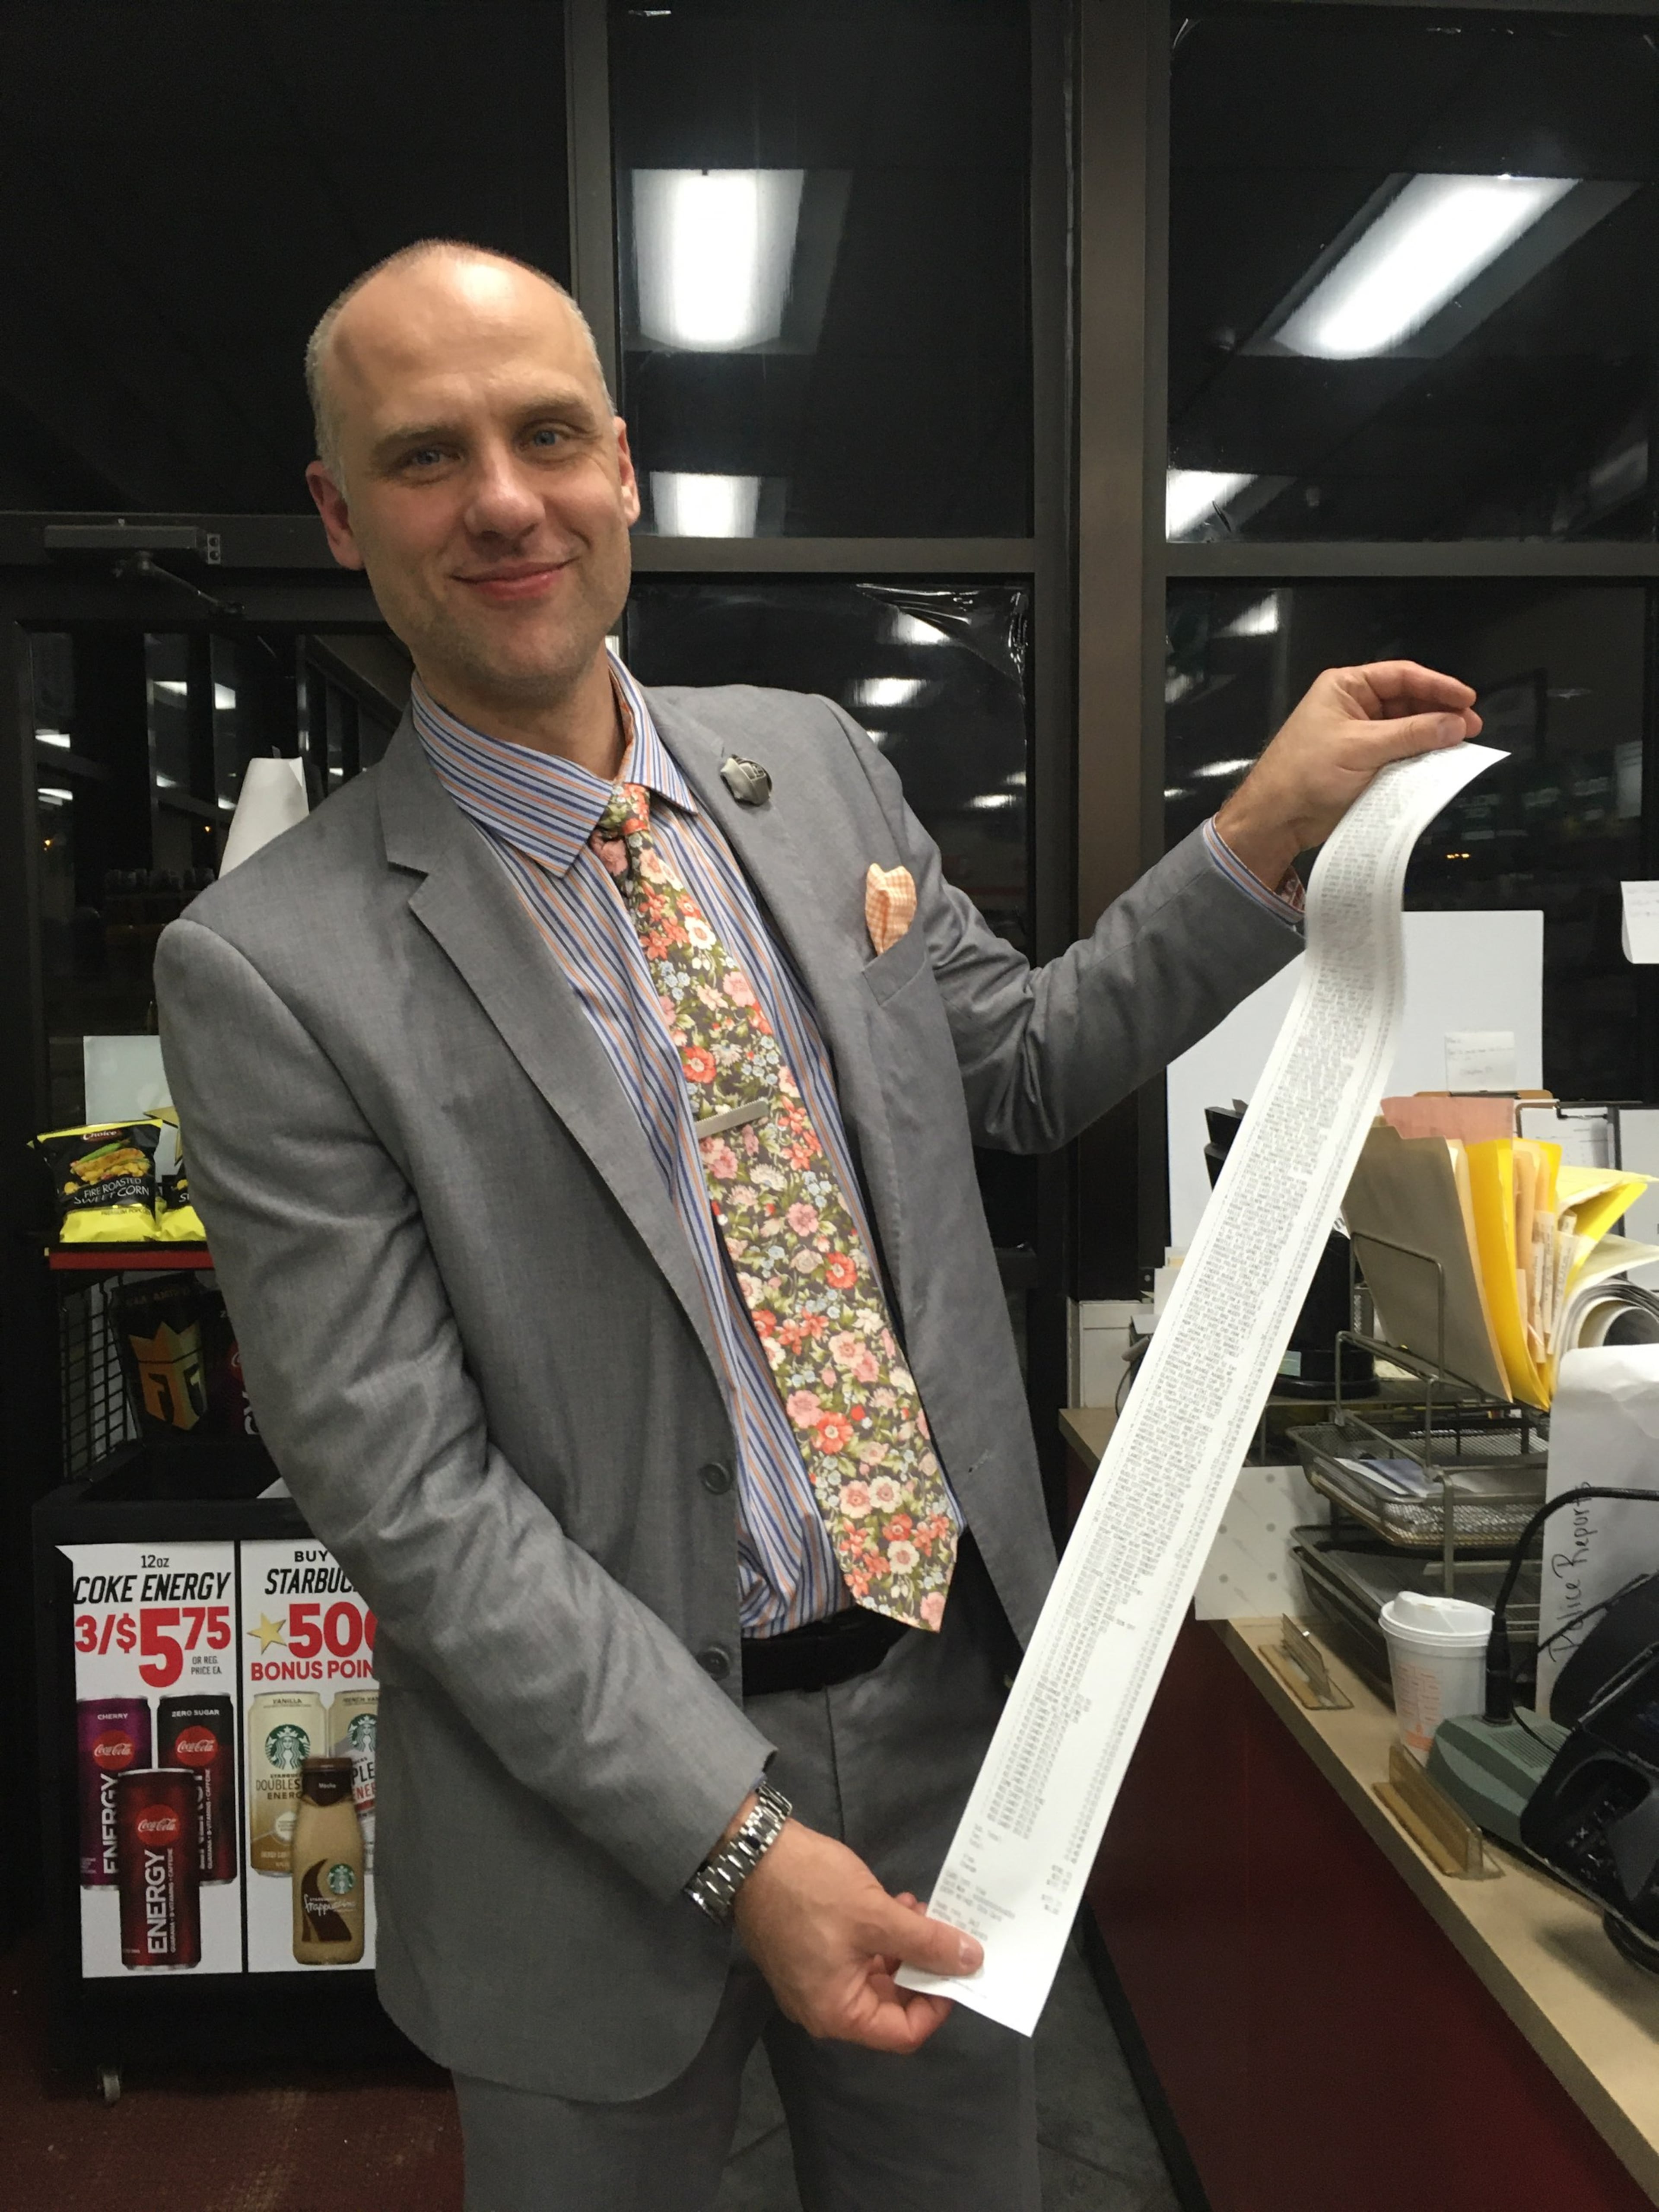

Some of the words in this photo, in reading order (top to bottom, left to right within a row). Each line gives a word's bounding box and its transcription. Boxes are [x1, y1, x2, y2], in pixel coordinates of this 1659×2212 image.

[84, 1188, 101, 1198] FIRE
[102, 1177, 141, 1194] ROASTED
[117, 1185, 149, 1197] CORN
[294, 1550, 328, 1562] BUY
[73, 1575, 137, 1605] COKE
[140, 1572, 231, 1602] ENERGY
[264, 1567, 358, 1595] STARBUC
[191, 1666, 210, 1675] PRICE
[251, 1661, 323, 1681] BONUS
[327, 1659, 375, 1679] POIN
[256, 1779, 301, 1791] DOUBLES
[267, 1791, 302, 1800] ENERG
[144, 1850, 168, 1954] ENERGY
